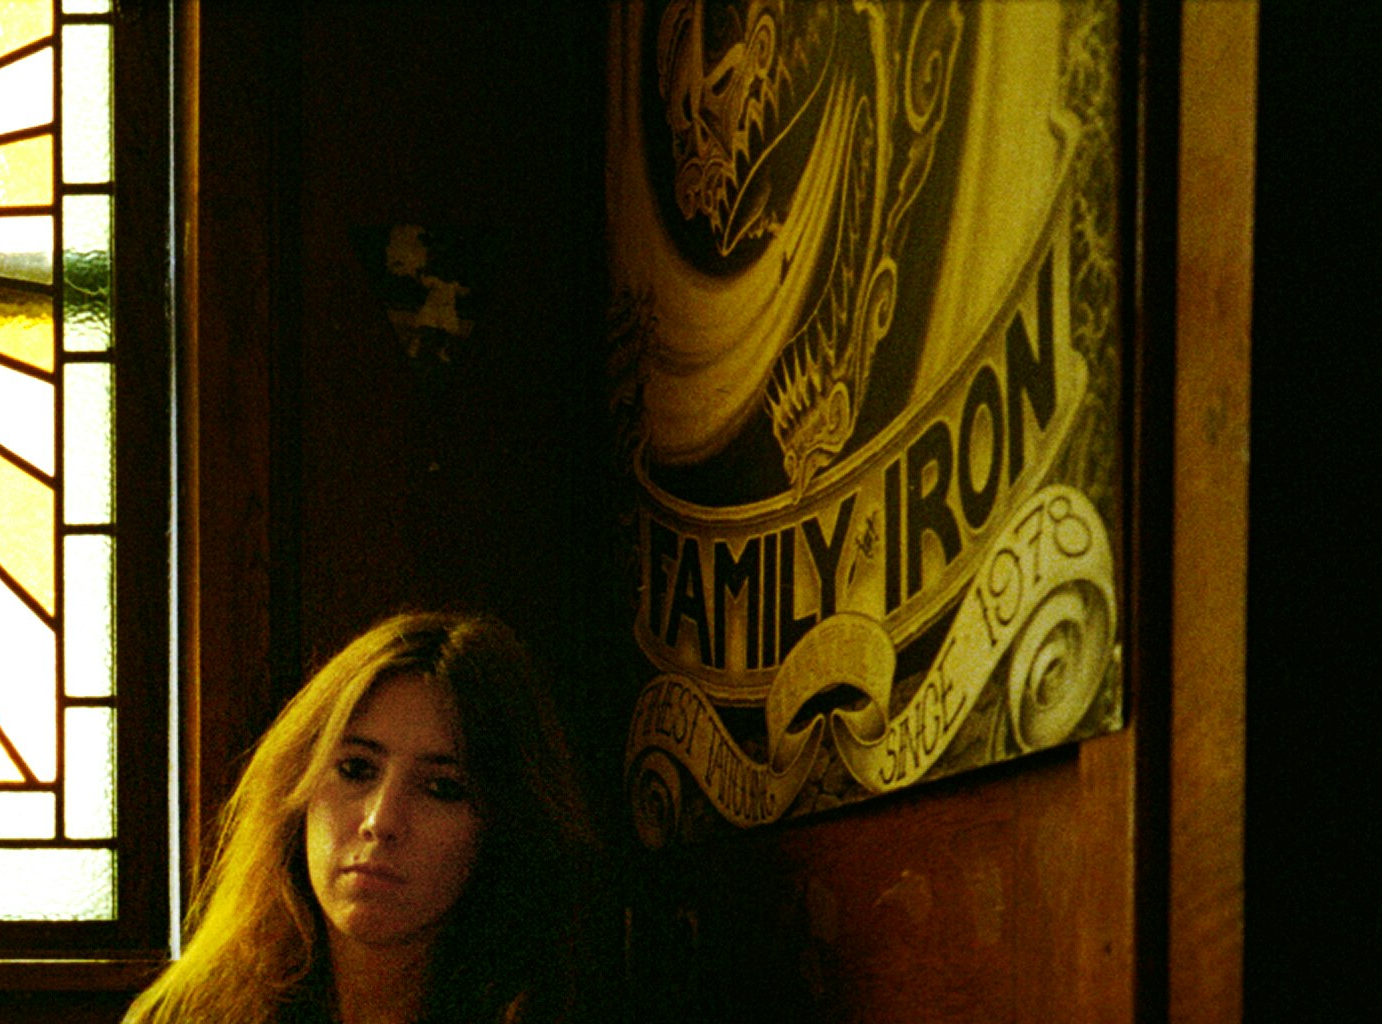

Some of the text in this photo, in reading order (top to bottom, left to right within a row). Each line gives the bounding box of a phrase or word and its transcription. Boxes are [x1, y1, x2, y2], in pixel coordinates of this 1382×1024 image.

[649, 243, 1058, 670] FAMILY IRON
[879, 497, 1092, 785] SINCE 1978
